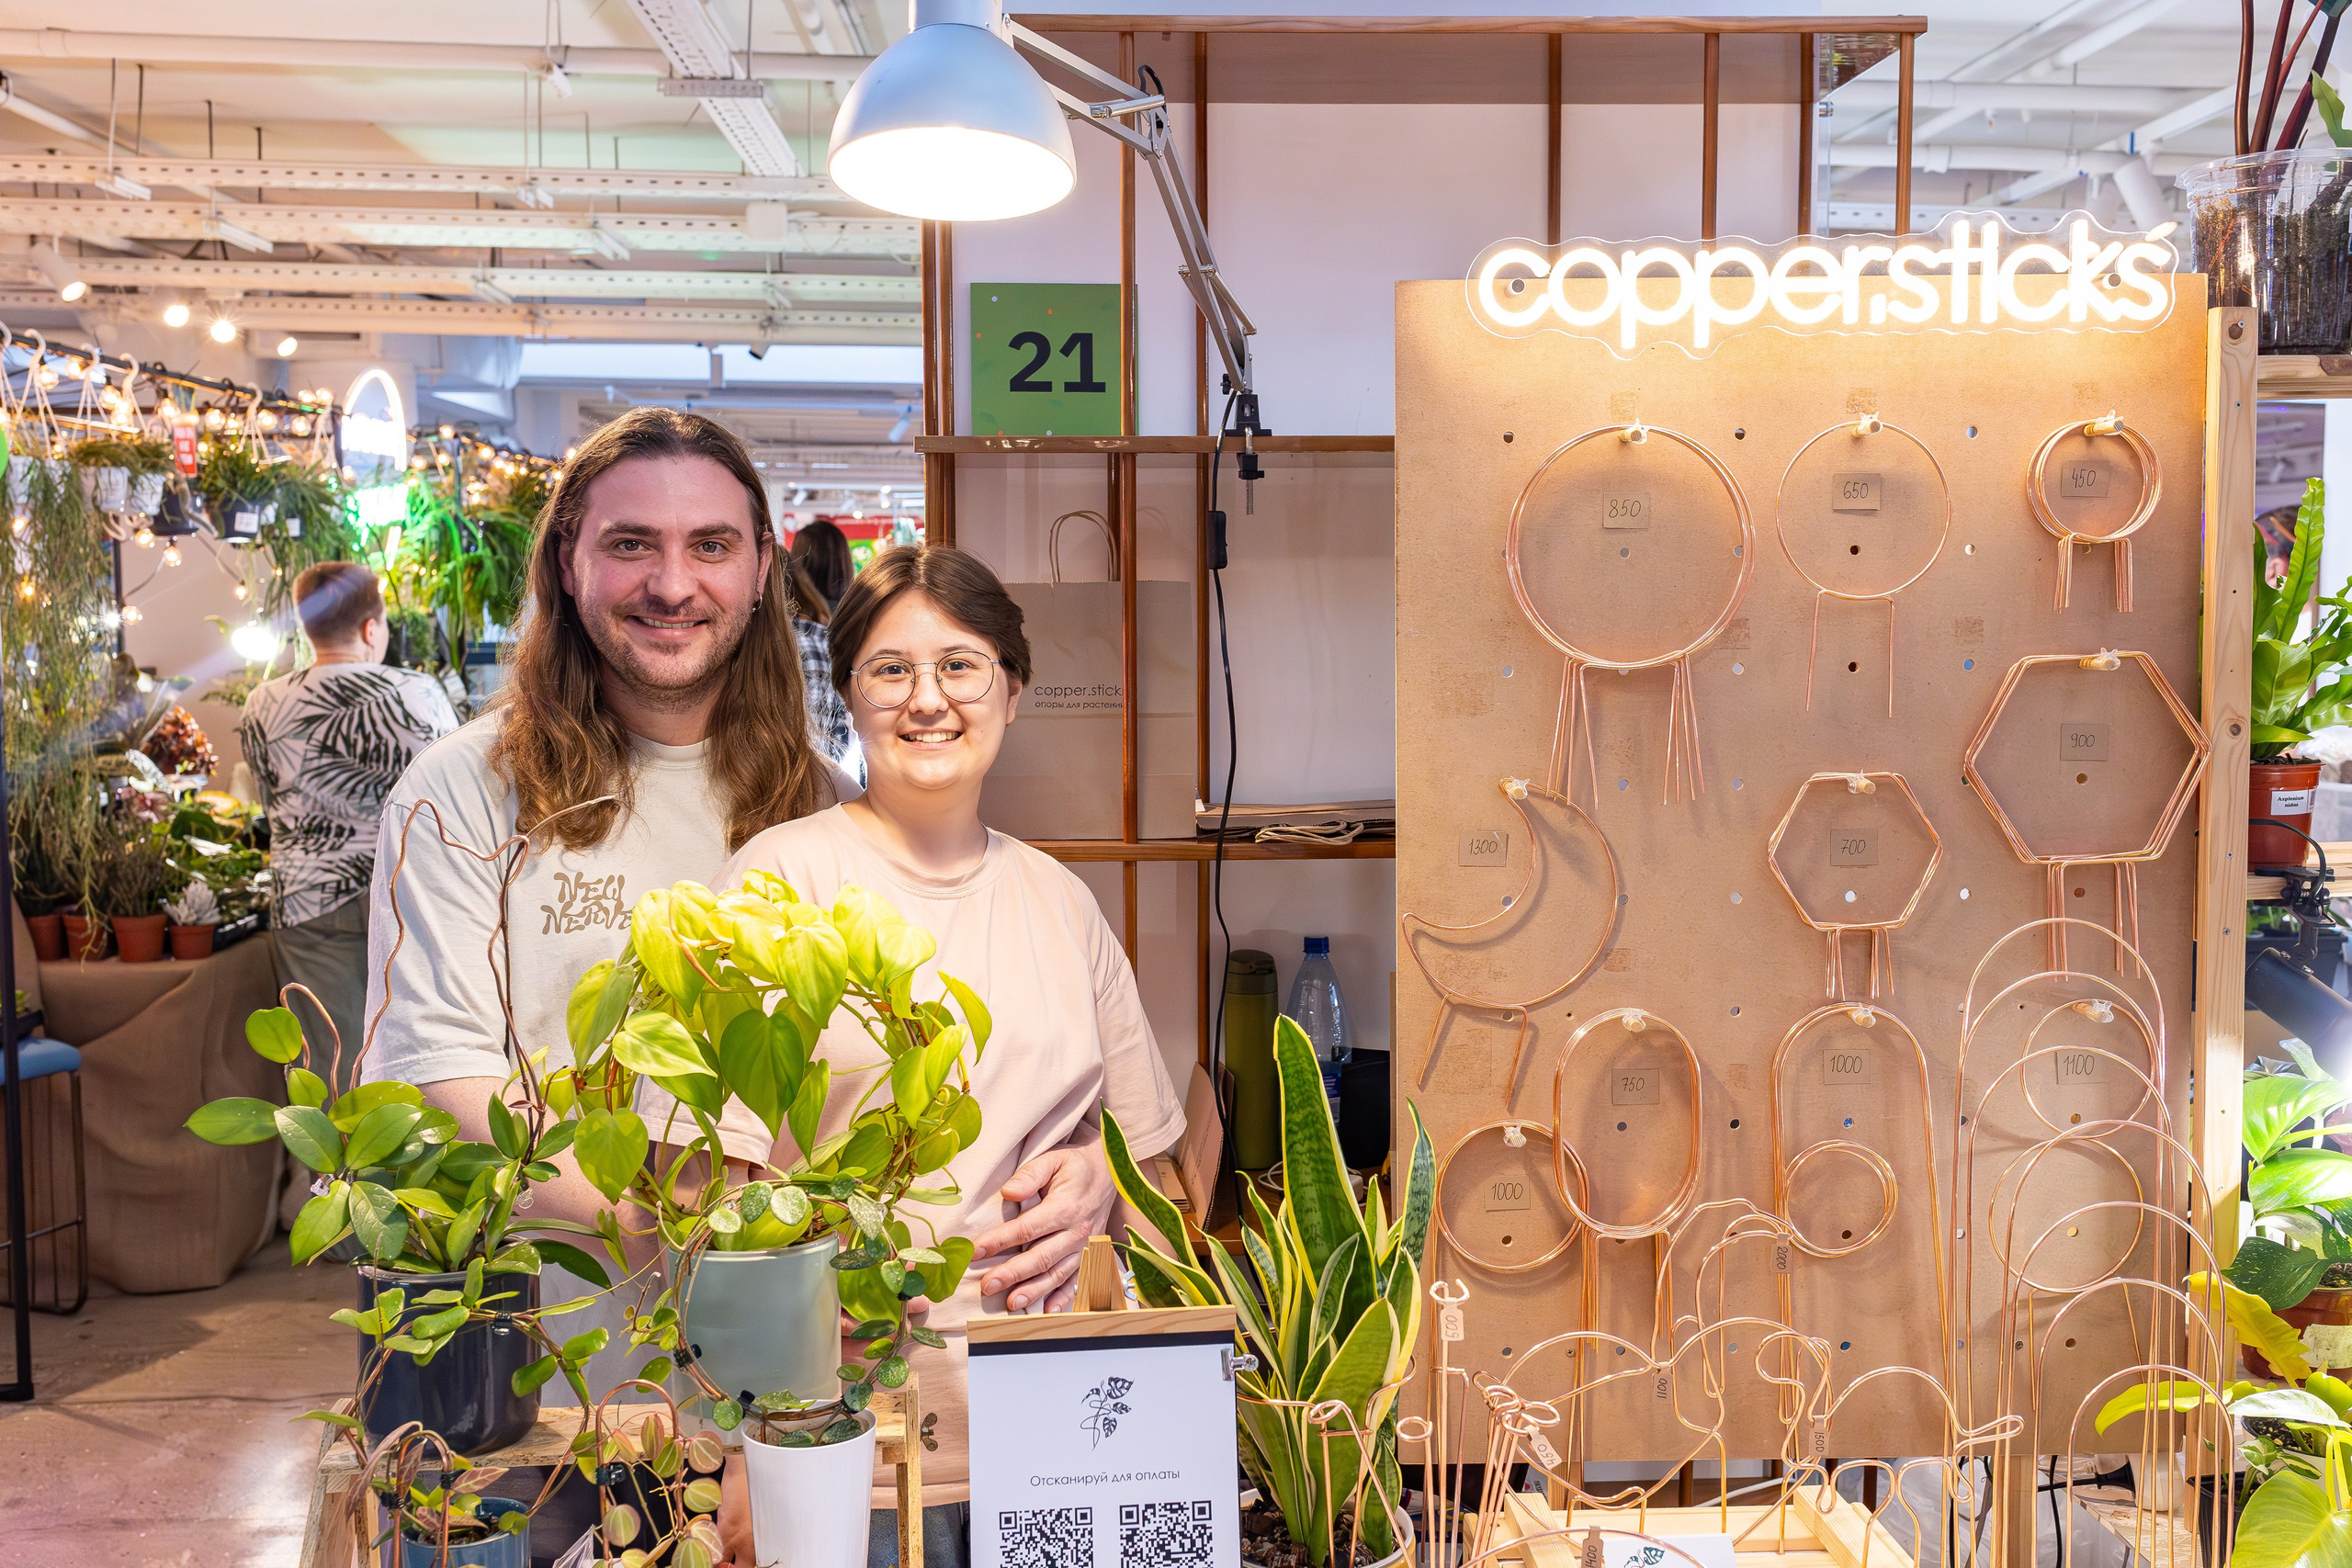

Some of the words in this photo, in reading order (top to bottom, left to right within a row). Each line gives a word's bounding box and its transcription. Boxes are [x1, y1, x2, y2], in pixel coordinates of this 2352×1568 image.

[1008, 331, 1106, 393] 21
[2072, 468, 2097, 488] 450
[1843, 480, 1869, 500] 650
[1608, 499, 1642, 519] 850
[1035, 684, 1123, 698] copper.stick
[2070, 732, 2096, 749] 900
[1468, 838, 1498, 855] 1300
[1840, 839, 1866, 856] 700
[553, 871, 626, 904] NEW
[1829, 1054, 1863, 1074] 1000
[2063, 1054, 2095, 1076] 1100
[1621, 1077, 1645, 1092] 750
[1491, 1182, 1524, 1201] 1000
[1776, 1246, 1789, 1270] 2000
[1445, 1314, 1460, 1338] 500
[1657, 1378, 1668, 1399] 1100
[1814, 1431, 1825, 1452] 1500
[1537, 1443, 1556, 1466] 450
[1030, 1472, 1108, 1487] Отсканируй
[1111, 1472, 1132, 1483] для
[1135, 1470, 1181, 1481] оплаты
